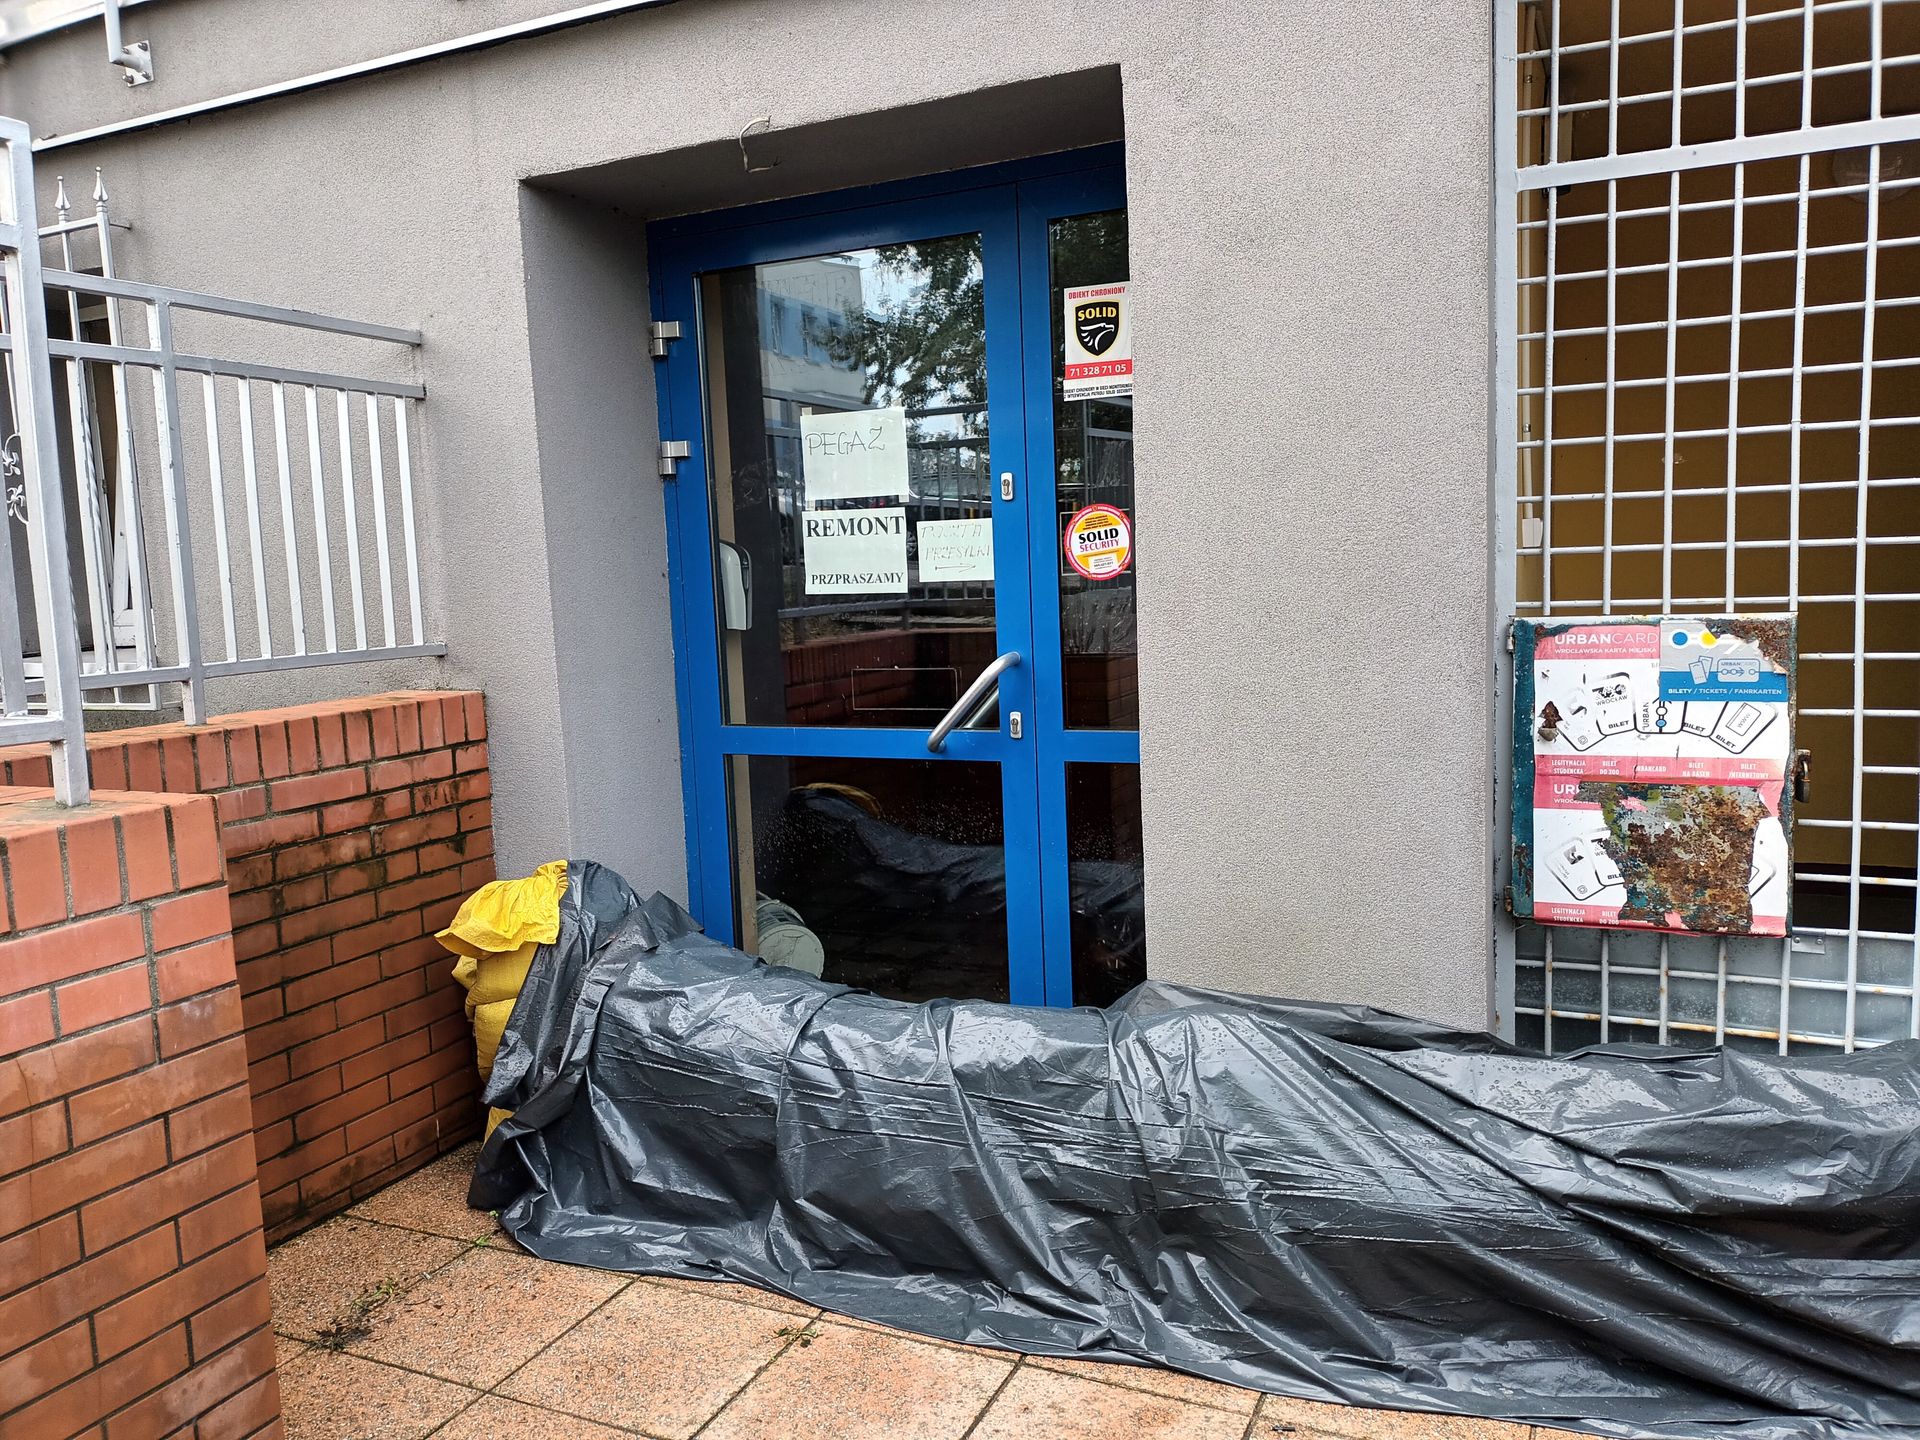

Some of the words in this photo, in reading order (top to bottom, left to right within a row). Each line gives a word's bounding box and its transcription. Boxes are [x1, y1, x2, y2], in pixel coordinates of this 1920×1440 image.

[1069, 291, 1089, 299] OBIEKT
[1091, 286, 1125, 297] CHRONIONY
[1078, 307, 1117, 321] SOLID
[1070, 368, 1080, 377] 71
[1083, 367, 1100, 376] 328
[1102, 365, 1112, 374] 71
[1115, 364, 1127, 373] 05
[805, 426, 886, 456] PEGAZ
[806, 516, 904, 537] REMONT
[1078, 528, 1119, 544] SOLID
[1080, 538, 1119, 553] SECURITY
[811, 572, 904, 585] PRZPRASZAMY
[1554, 633, 1659, 645] URBANCARD
[1608, 720, 1630, 729] BILET
[1683, 722, 1706, 732] BILET
[1715, 734, 1736, 749] BILET
